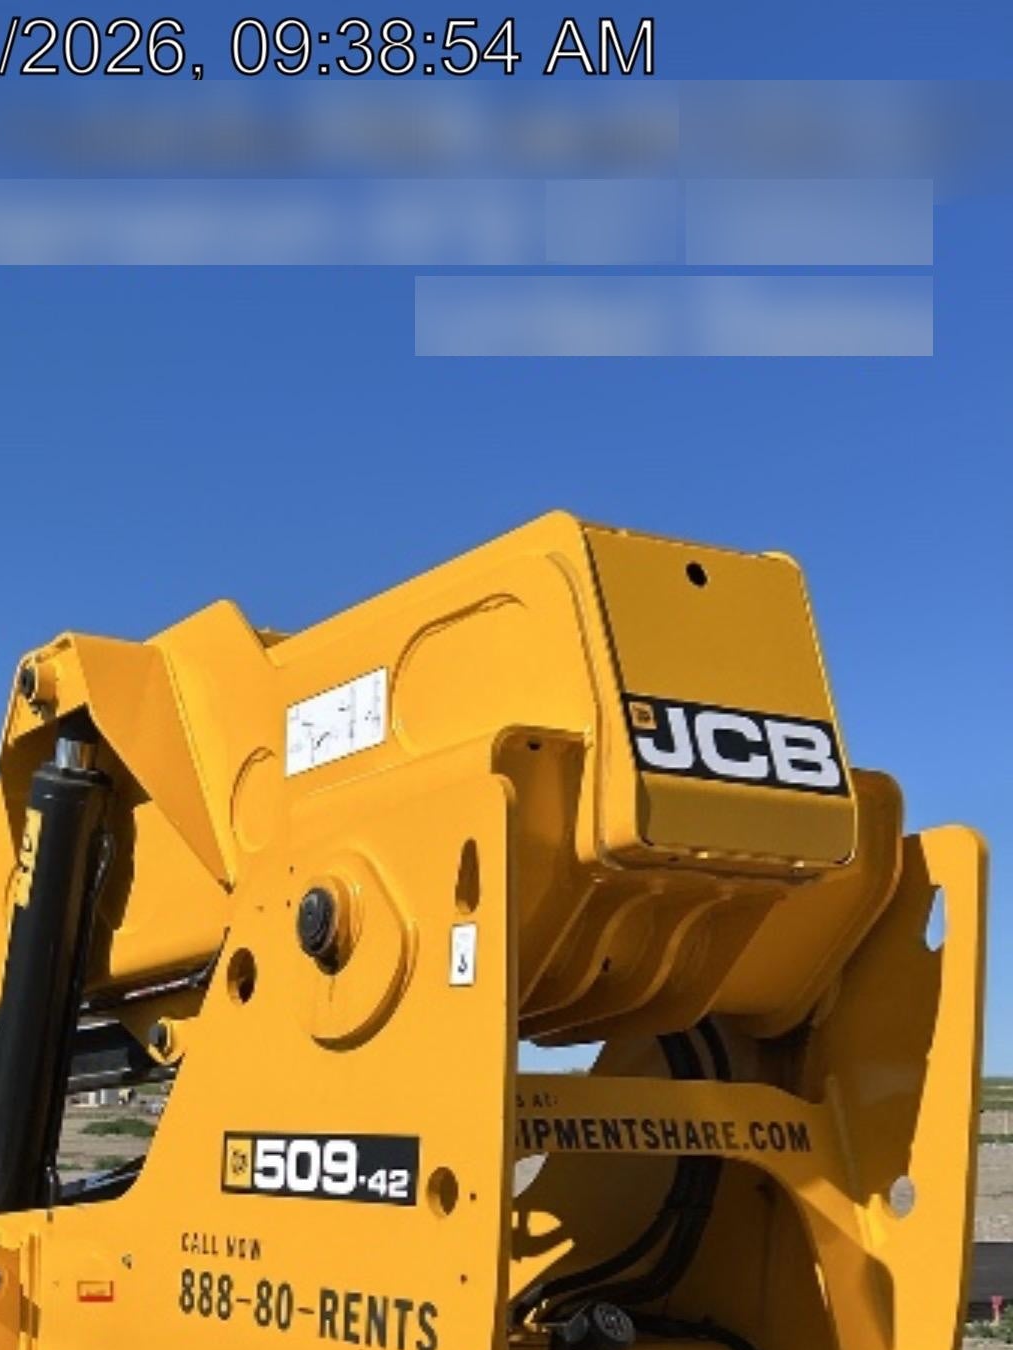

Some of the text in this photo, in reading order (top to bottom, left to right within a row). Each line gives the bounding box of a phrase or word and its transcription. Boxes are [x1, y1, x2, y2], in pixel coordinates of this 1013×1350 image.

[636, 706, 841, 788] JCB
[515, 1117, 812, 1153] IPMENTSHARE.COM
[181, 1232, 261, 1261] CALL NOW
